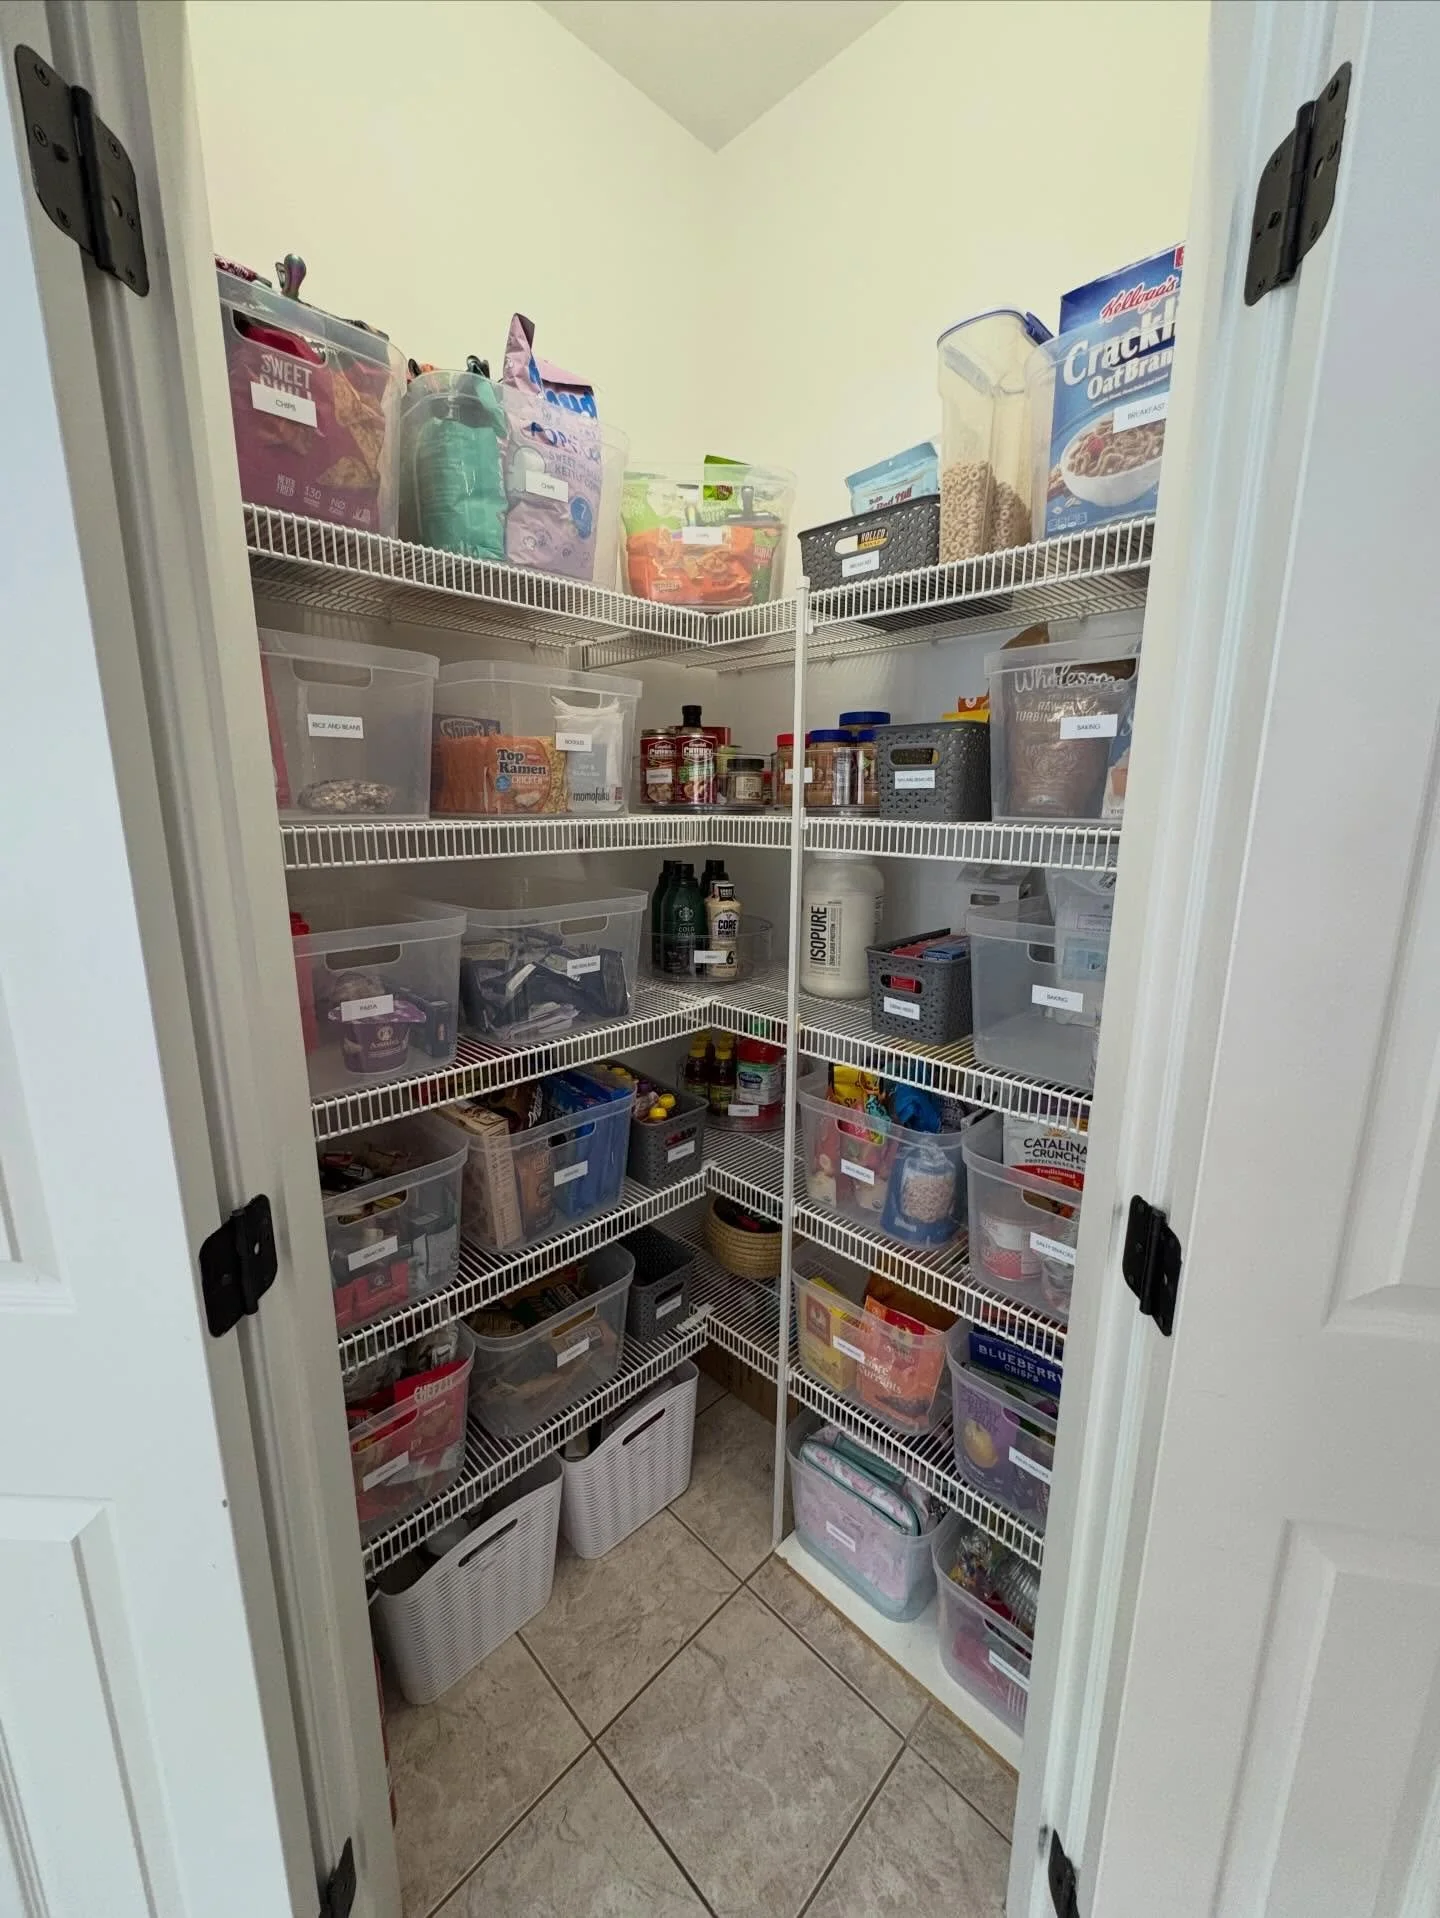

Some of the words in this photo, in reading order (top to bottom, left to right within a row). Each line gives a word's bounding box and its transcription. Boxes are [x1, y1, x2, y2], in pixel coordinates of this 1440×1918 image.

[1100, 275, 1179, 323] Kellogg's
[262, 354, 312, 389] SWEET
[1087, 365, 1125, 400] Oat
[1125, 350, 1173, 382] Bran
[275, 399, 297, 412] CHIPS
[1127, 403, 1166, 420] BREAKFAST
[305, 486, 321, 499] 130
[328, 722, 341, 730] AND
[342, 723, 361, 731] BEANS
[1077, 723, 1101, 731] BAKING
[496, 747, 525, 765] Top
[498, 760, 548, 775] Ramen
[512, 775, 543, 785] CHICKEN
[573, 787, 610, 804] momofuku
[718, 919, 737, 930] CORE
[810, 906, 827, 965] ISOPURE
[1023, 1138, 1088, 1156] CATALINA
[1032, 1147, 1079, 1164] CRUNCH
[1035, 1167, 1076, 1180] Traditional
[1004, 1363, 1039, 1384] CRISPS
